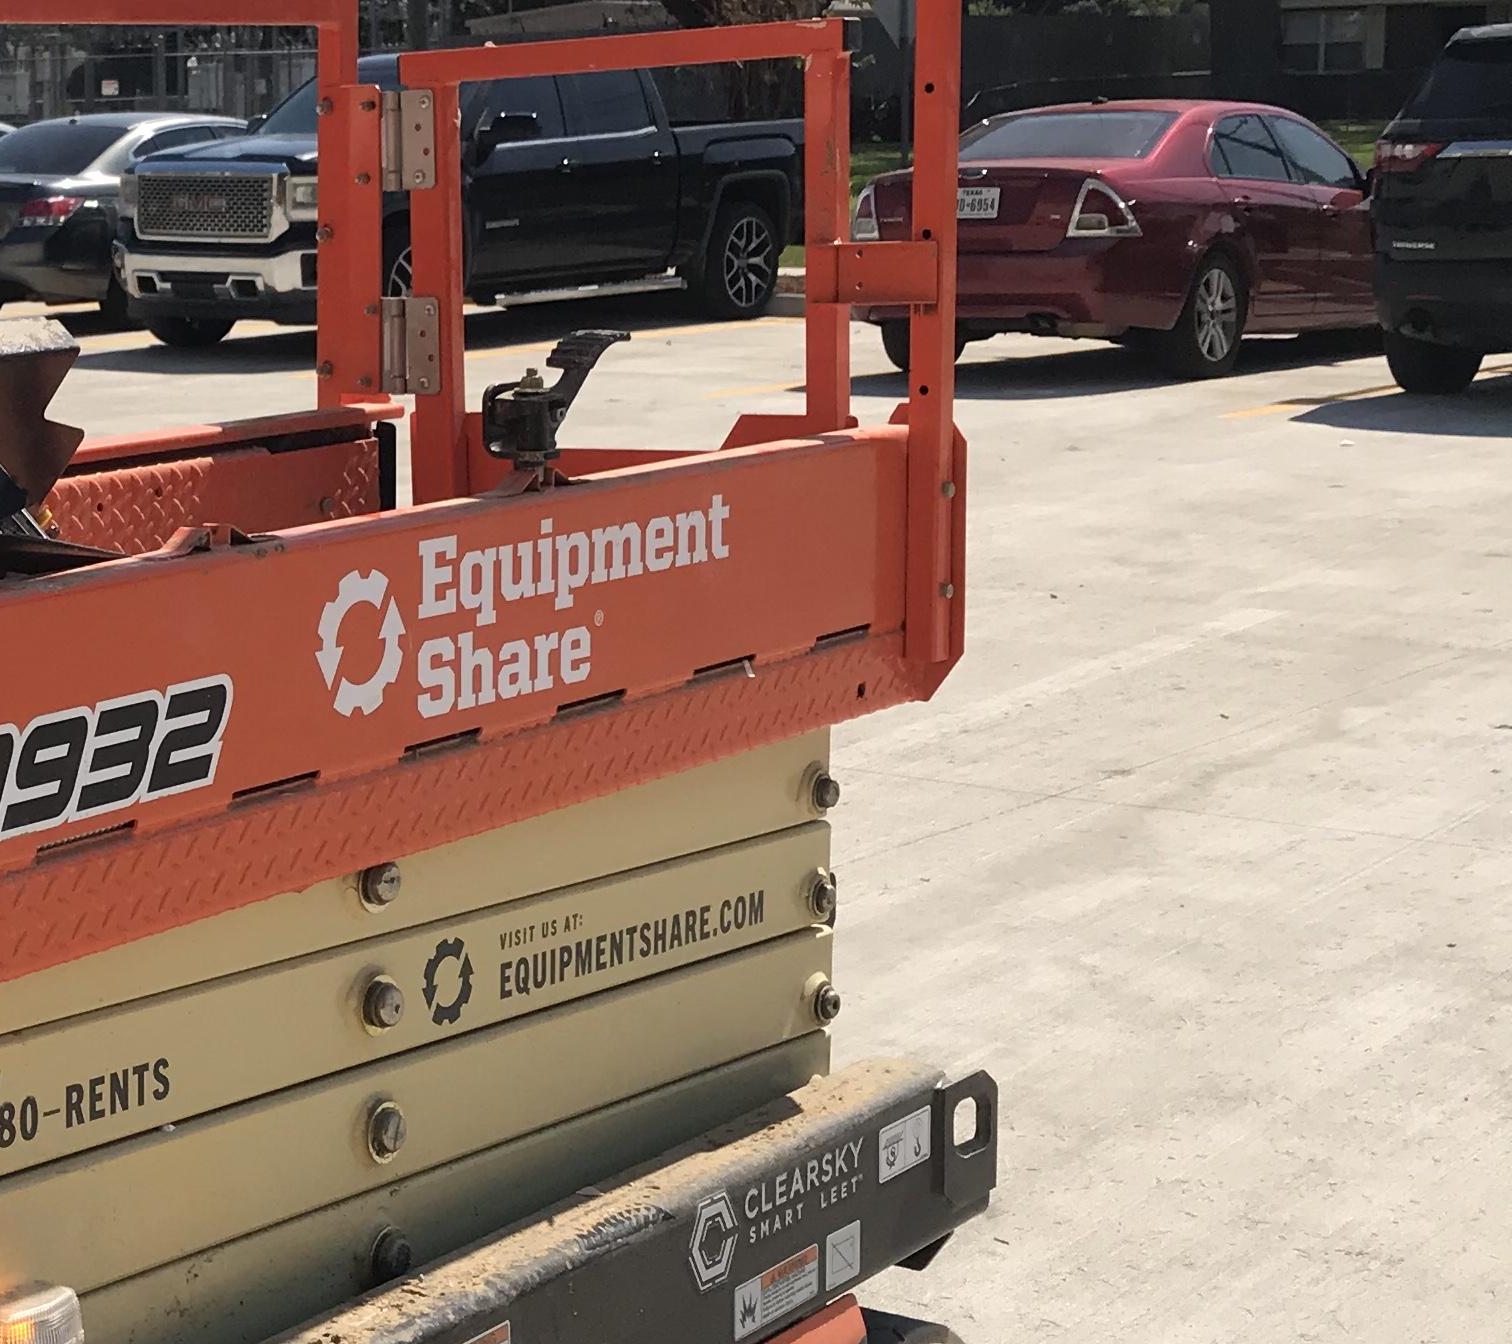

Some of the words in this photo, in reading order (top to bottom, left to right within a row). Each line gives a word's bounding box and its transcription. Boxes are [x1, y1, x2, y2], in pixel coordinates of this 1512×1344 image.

[417, 493, 730, 626] Equipment
[416, 624, 594, 720] Share
[499, 925, 536, 950] VISIT
[541, 919, 557, 939] US
[563, 912, 583, 933] AT:
[499, 889, 765, 1000] EQUIPMENTSHARE.COM
[744, 1136, 864, 1220] CLEARSKY
[749, 1202, 804, 1244] SMART
